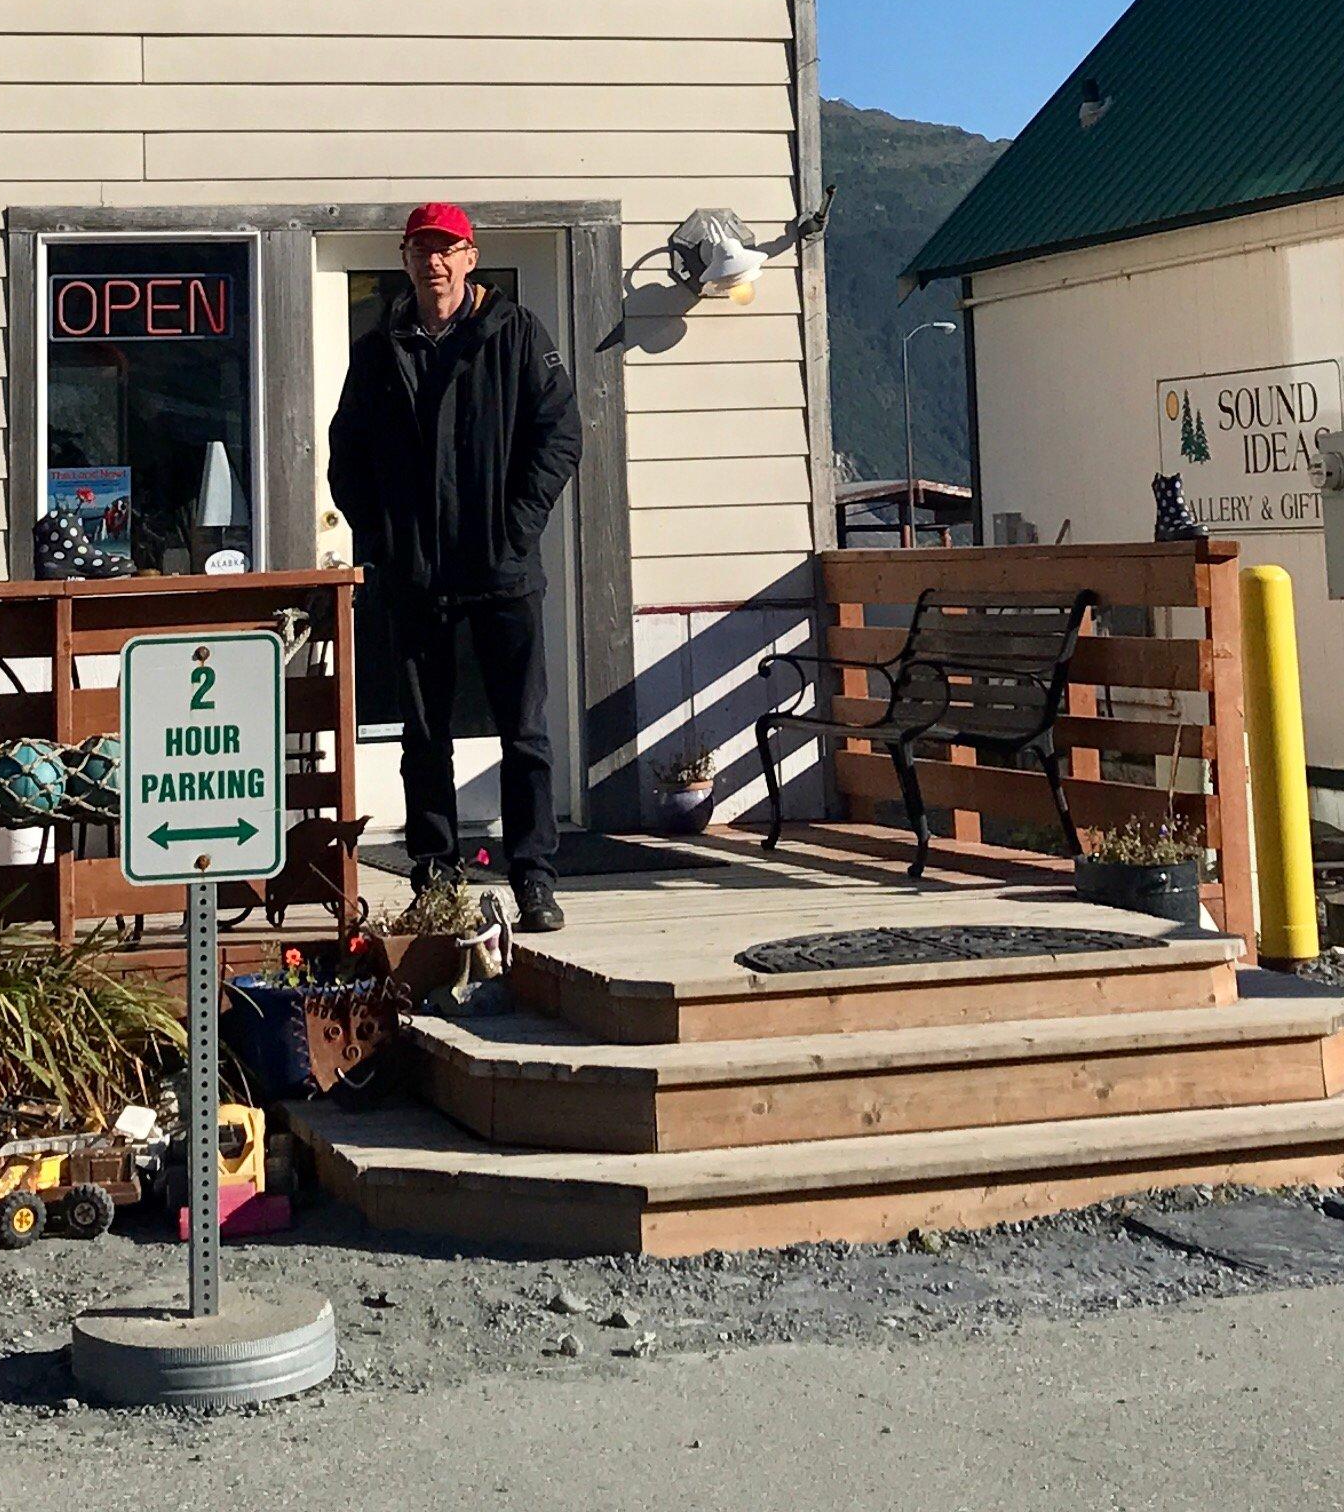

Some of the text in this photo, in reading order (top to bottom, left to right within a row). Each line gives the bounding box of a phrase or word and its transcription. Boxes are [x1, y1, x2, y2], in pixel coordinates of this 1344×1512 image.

[57, 278, 229, 335] OPEN
[1218, 381, 1318, 430] SOUND
[1189, 492, 1323, 524] ALLERY & GIFT
[190, 666, 216, 710] 2
[165, 724, 240, 757] HOUR
[141, 768, 265, 803] PARKING
